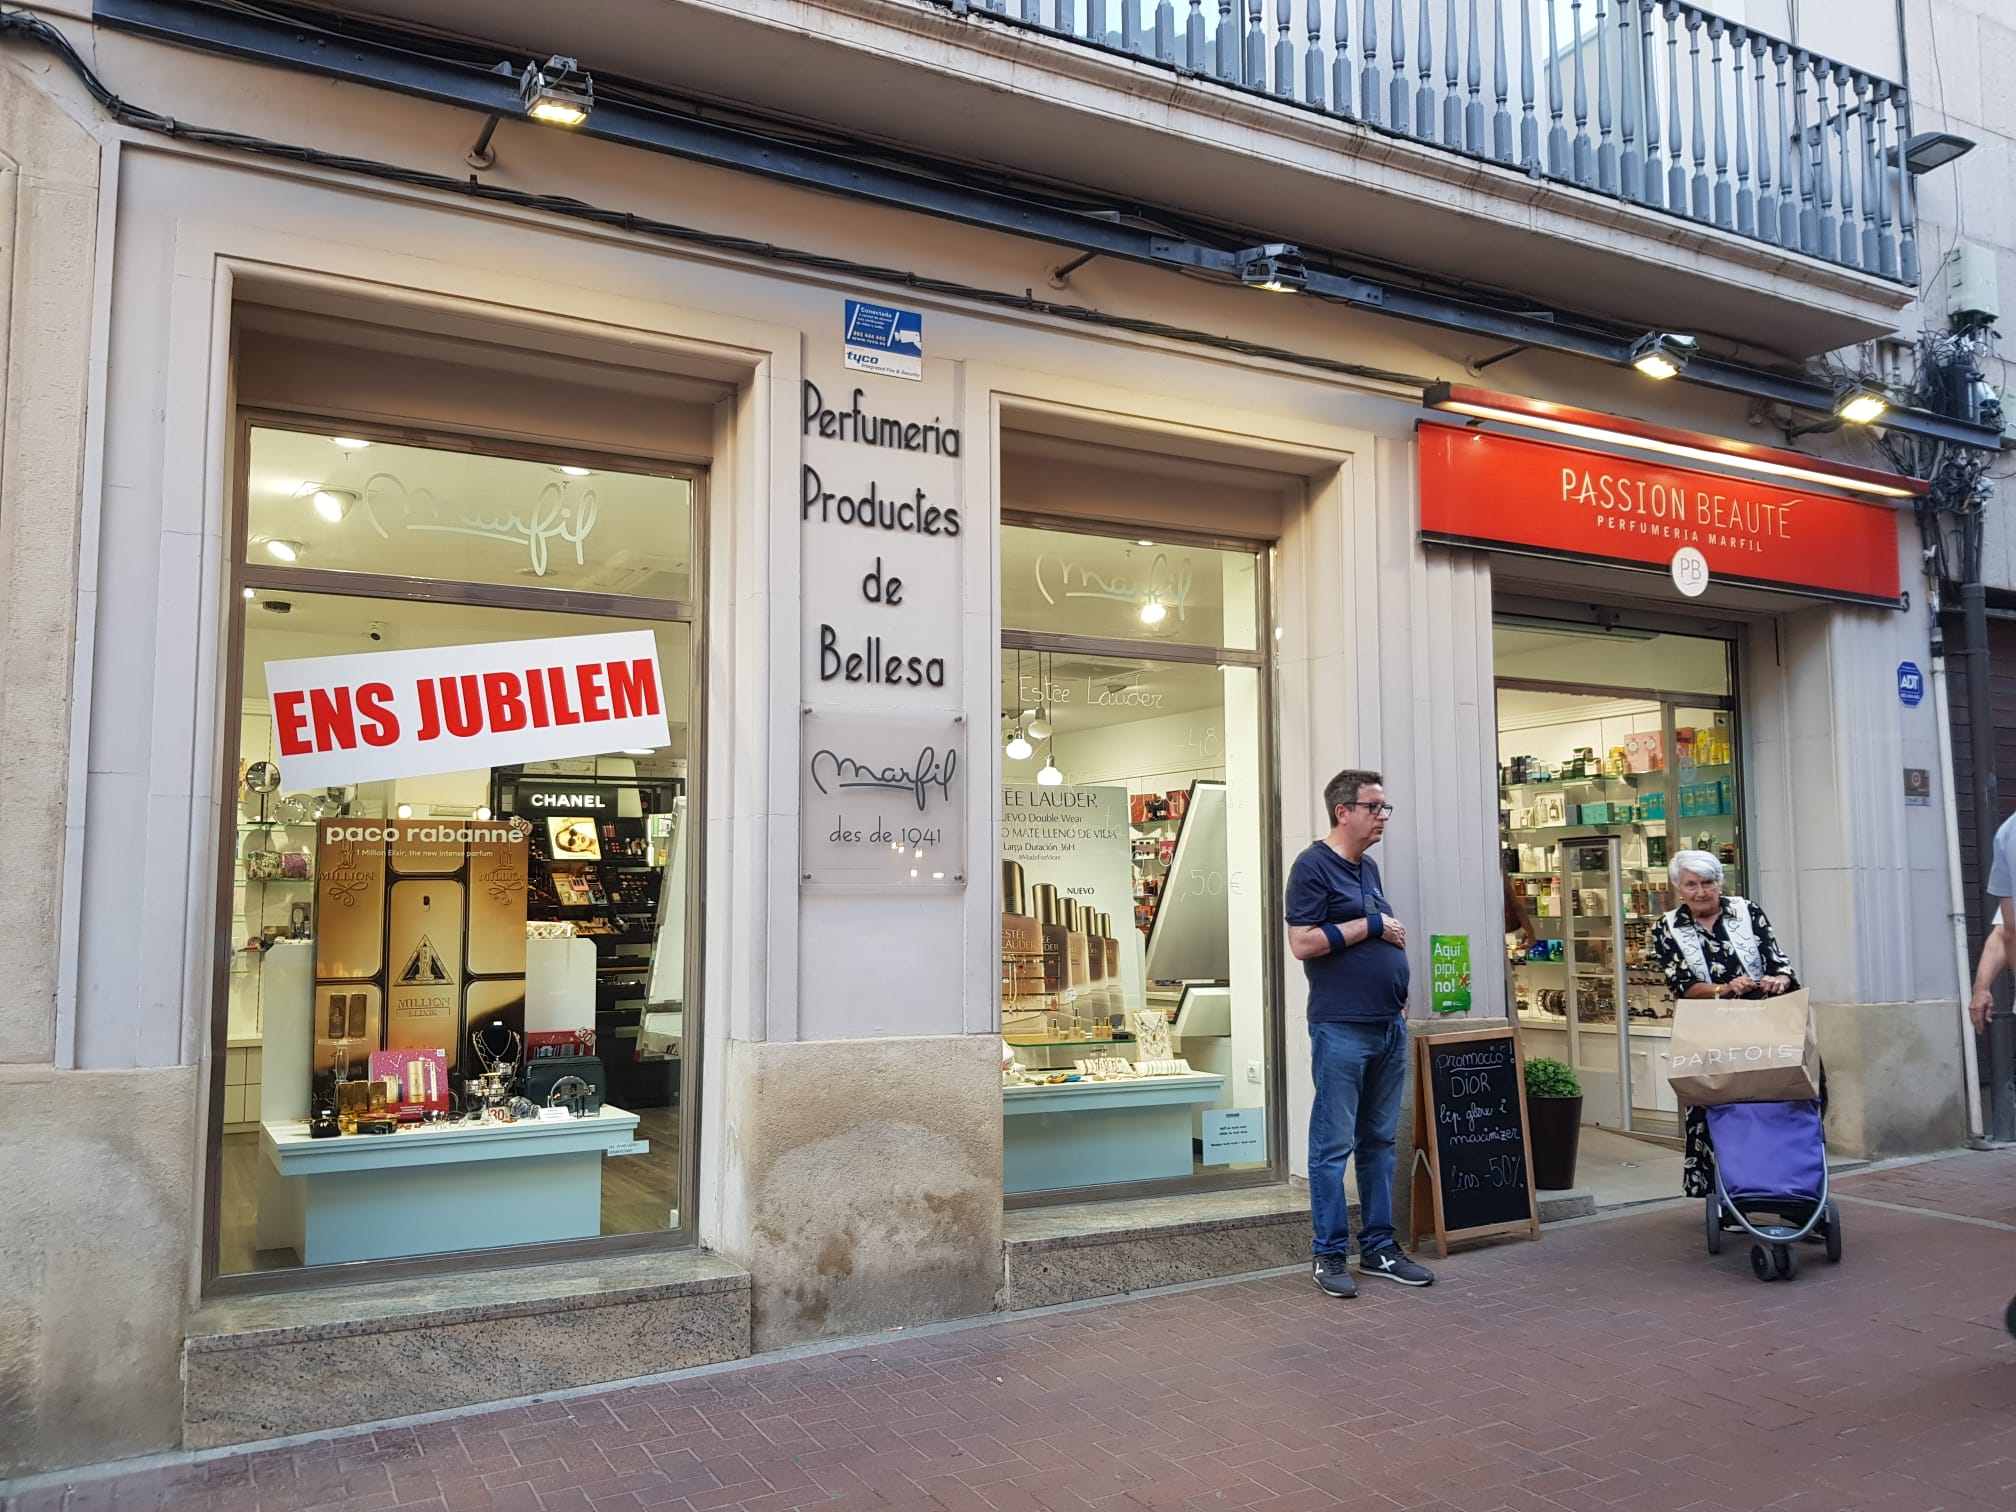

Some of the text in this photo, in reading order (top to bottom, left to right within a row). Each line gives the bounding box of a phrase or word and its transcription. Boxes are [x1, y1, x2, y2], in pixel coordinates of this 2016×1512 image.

[847, 351, 879, 364] tyco
[803, 464, 960, 536] Productes
[1562, 467, 1686, 521] PASSION
[363, 473, 598, 577] Marfil
[1597, 515, 1763, 553] PERFUMERIA MARFIL
[1680, 557, 1702, 580] PB
[863, 557, 903, 605] de
[820, 624, 944, 686] Bellesa
[1087, 675, 1164, 708] Lauder
[1900, 674, 1919, 690] ADT
[273, 658, 660, 757] ENS JUBILEM
[811, 746, 957, 811] Marfil
[531, 794, 606, 808] CHANEL
[1030, 791, 1098, 808] LAUDER
[1029, 813, 1059, 823] Double
[1061, 814, 1083, 823] Wear
[326, 825, 523, 845] paco rabanne
[829, 815, 941, 849] des de 1941
[1012, 828, 1040, 838] MATE
[1042, 828, 1076, 839] LLENO
[1078, 829, 1092, 839] DE
[1094, 829, 1118, 840] VIDA
[362, 848, 386, 856] Million
[1003, 843, 1022, 852] Larga
[1025, 842, 1058, 851] Duración
[320, 871, 375, 881] MILLION
[1067, 887, 1095, 895] NUEVO
[1434, 942, 1461, 960] Aquí
[1434, 978, 1456, 993] no!
[398, 997, 451, 1009] MILLION
[1672, 1044, 1793, 1069] PARFOIS
[1440, 1104, 1461, 1133] lip
[1450, 1127, 1521, 1145] maximizer
